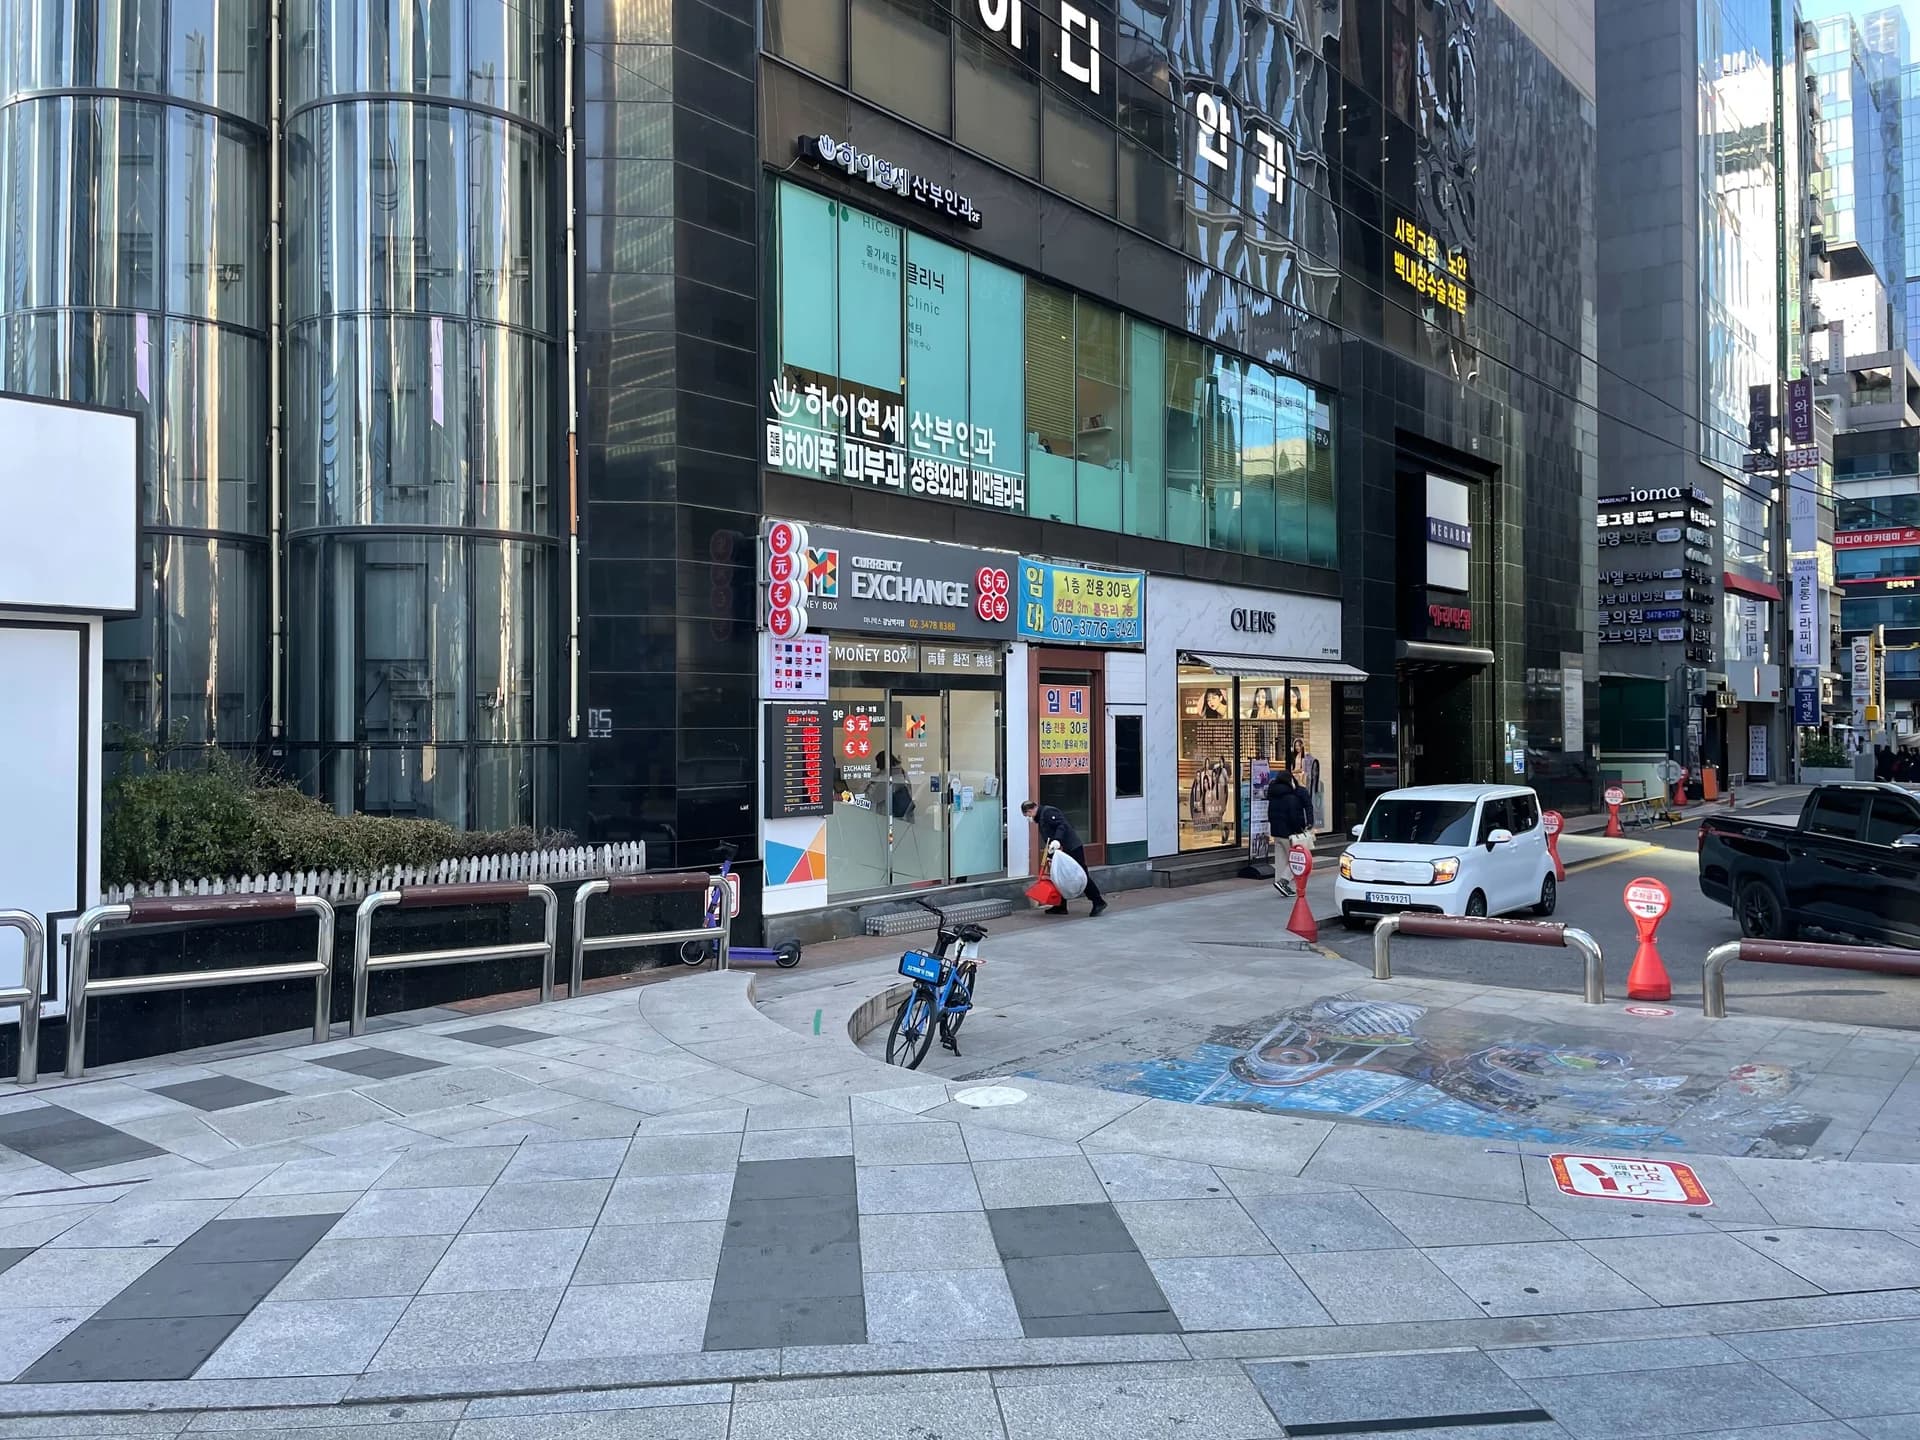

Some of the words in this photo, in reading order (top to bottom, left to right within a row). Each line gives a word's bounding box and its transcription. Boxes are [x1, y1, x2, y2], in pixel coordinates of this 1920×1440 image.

[1196, 92, 1287, 204] 안과
[836, 142, 910, 196] 하이연세
[913, 175, 973, 221] 산부인과
[866, 245, 899, 266] 줄기세포
[1448, 249, 1467, 281] 노안
[908, 262, 944, 295] 클리닉
[908, 295, 940, 316] Clinic
[804, 383, 904, 444] 하이연세
[911, 410, 996, 464] 산부인과
[785, 429, 837, 476] 하이푸
[844, 442, 906, 489] 피부과
[911, 457, 968, 501] 성형외과
[972, 469, 1025, 511] 비만클리닉
[1630, 486, 1682, 502] ioma
[1431, 522, 1471, 544] MEGABOX
[851, 556, 902, 572] CURRENCY
[851, 571, 969, 607] EXCHANGE
[1086, 578, 1104, 597] 전용
[822, 601, 838, 610] BOX
[909, 619, 918, 629] 02
[1052, 617, 1137, 638] 010-3776-3421
[1230, 608, 1276, 634] OLENS
[835, 646, 880, 663] MONEY
[883, 650, 907, 664] BOX
[953, 653, 970, 667] 환전
[1391, 895, 1408, 903] 9121
